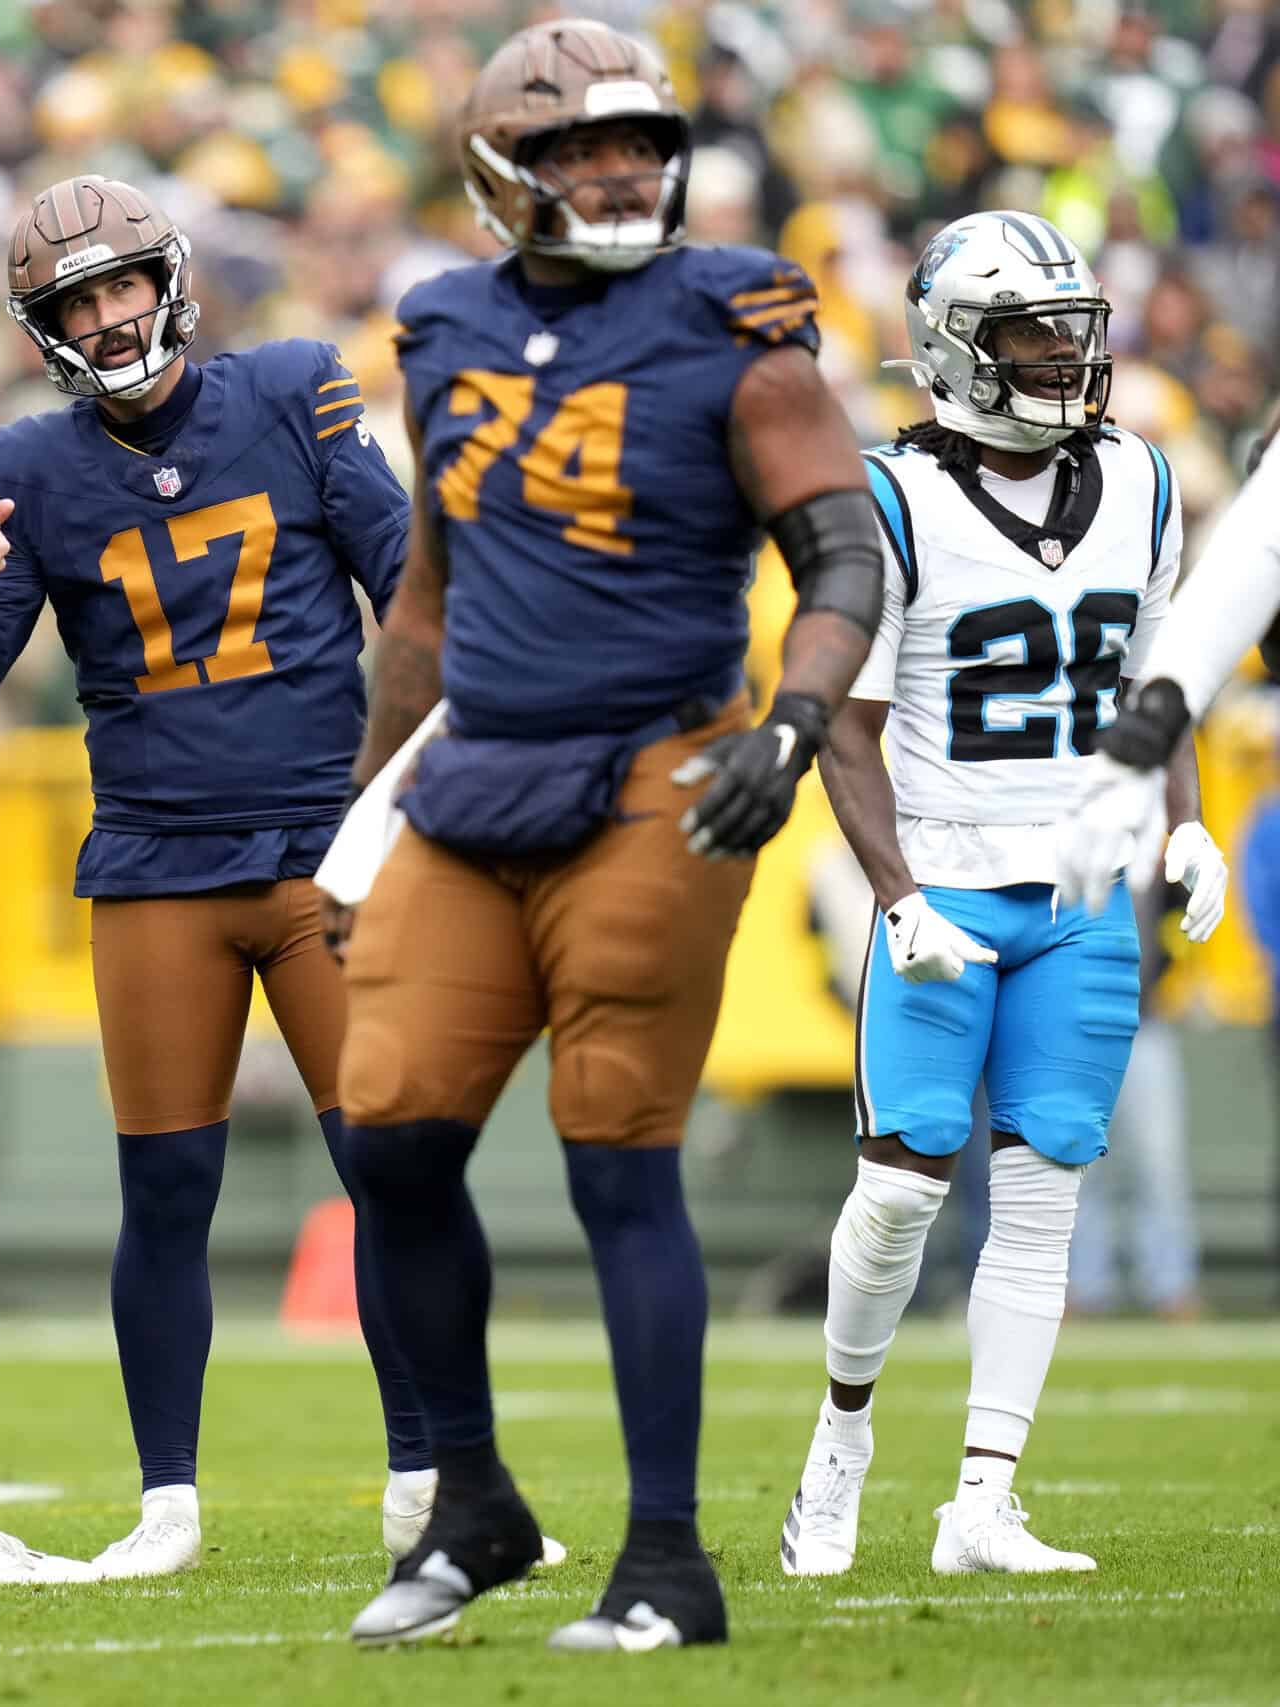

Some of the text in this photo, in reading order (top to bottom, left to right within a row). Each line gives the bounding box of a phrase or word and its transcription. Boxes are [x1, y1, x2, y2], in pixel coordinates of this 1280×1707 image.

[436, 369, 634, 553] 74
[99, 491, 277, 695] 17
[946, 587, 1141, 762] 26
